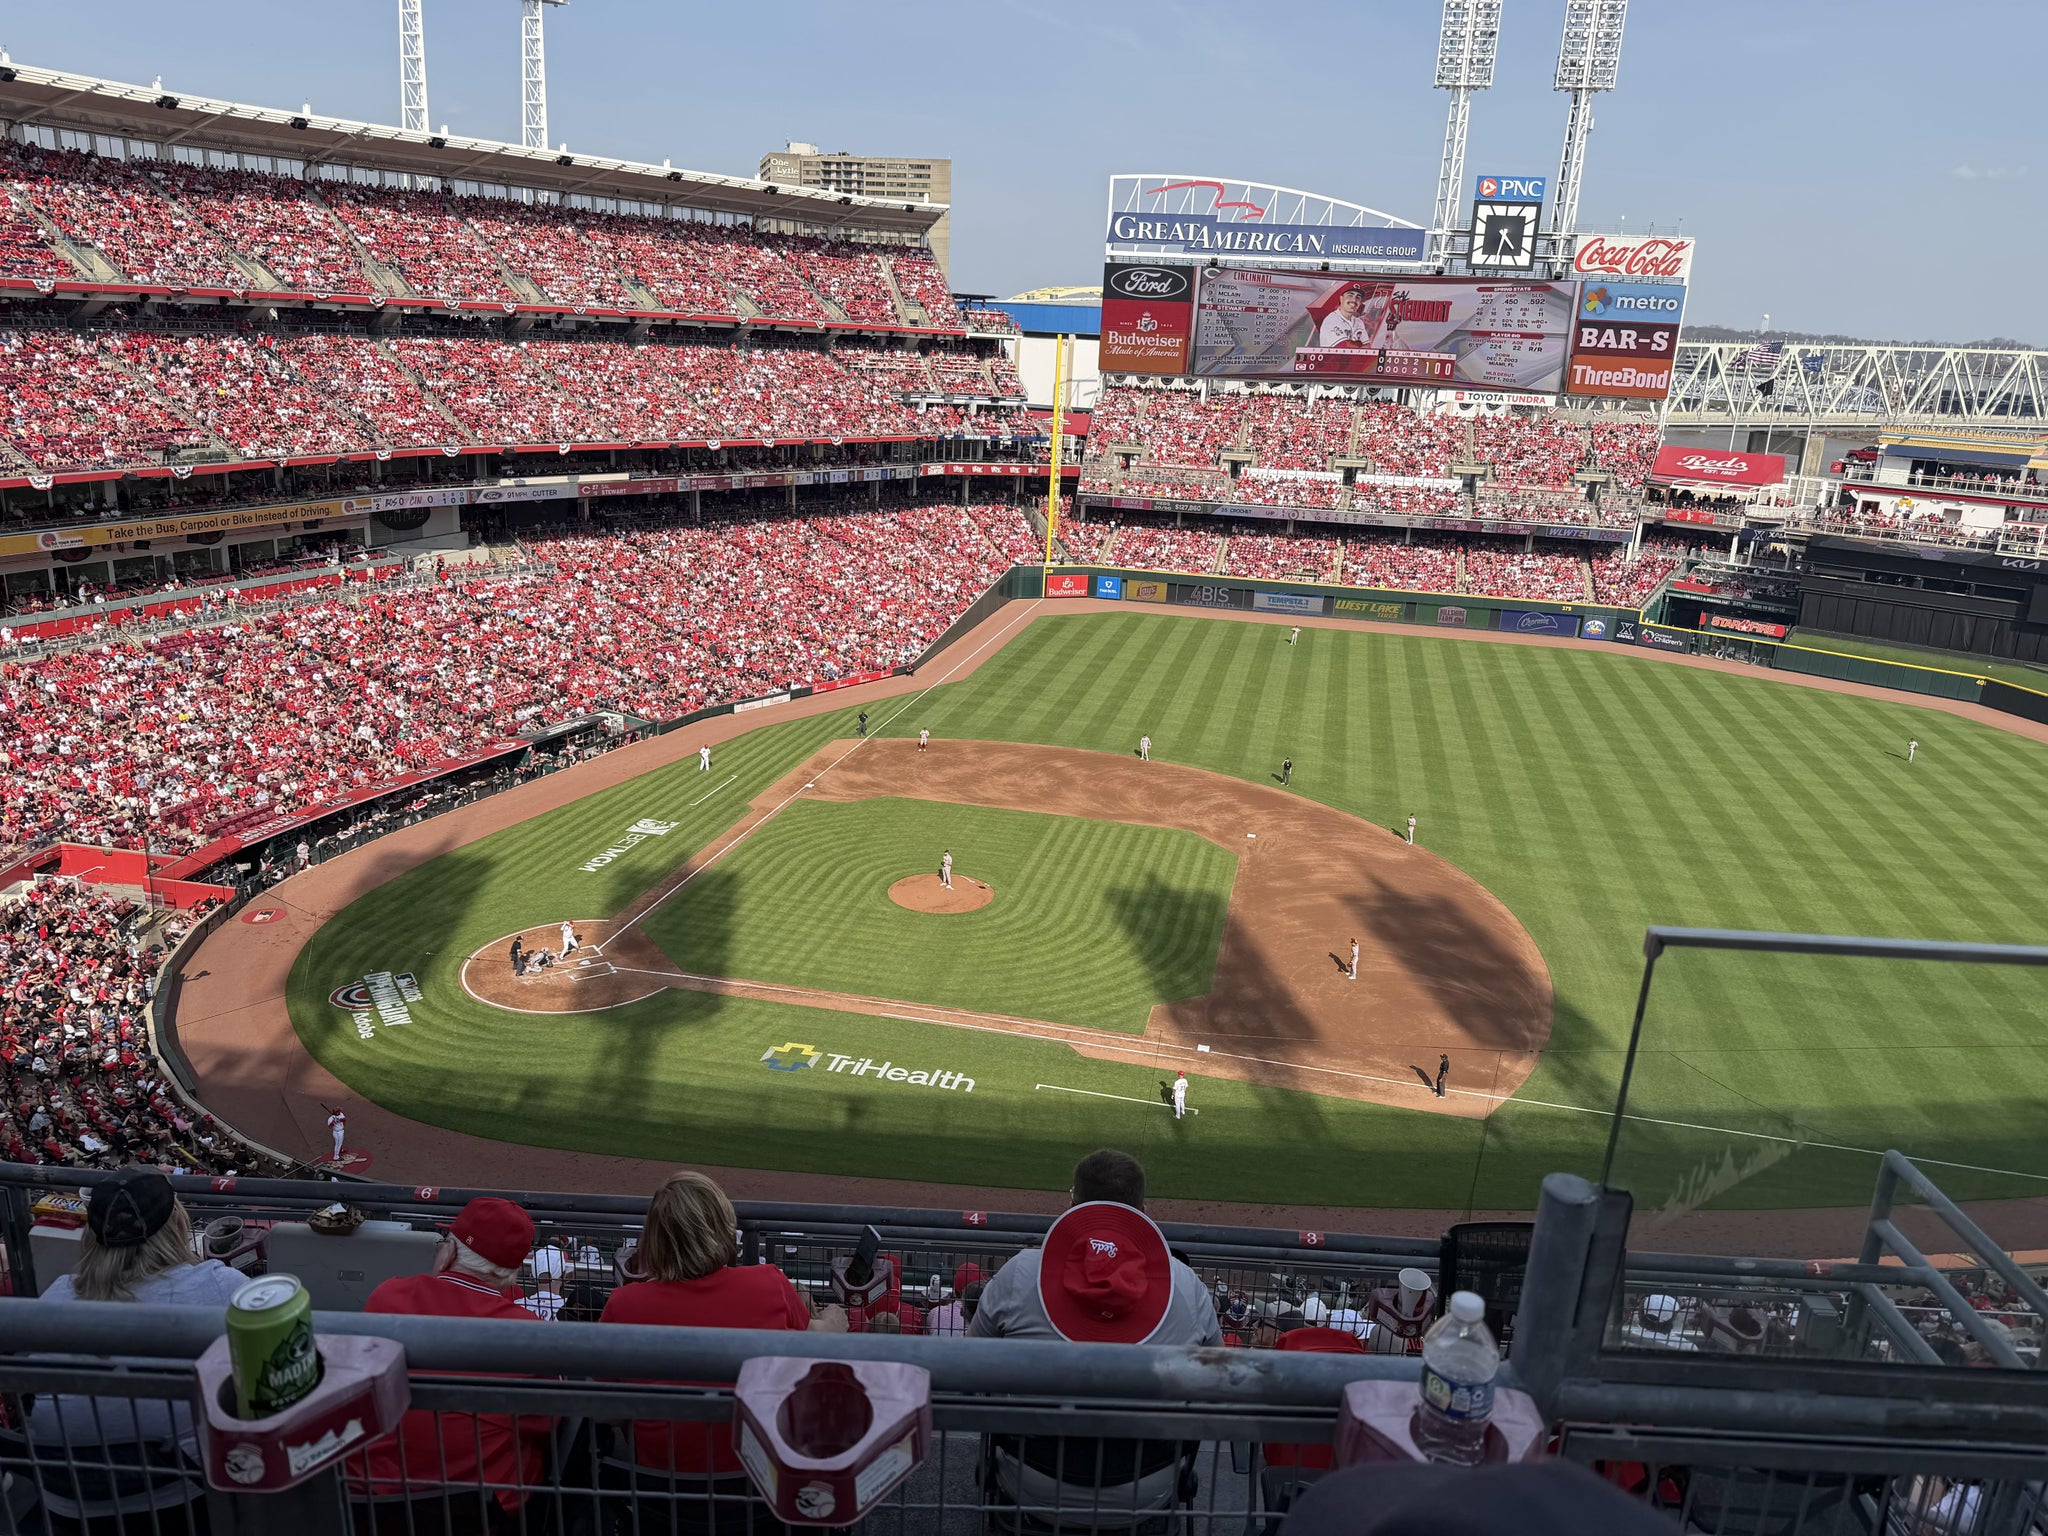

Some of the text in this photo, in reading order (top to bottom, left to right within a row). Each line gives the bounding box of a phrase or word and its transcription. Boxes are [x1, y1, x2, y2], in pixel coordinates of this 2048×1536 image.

[1500, 180, 1542, 197] PNC
[1114, 216, 1200, 241] GREAT
[1332, 244, 1383, 255] INSURANCE
[1387, 247, 1417, 256] GROUP
[1125, 271, 1172, 293] Ford
[1234, 272, 1271, 283] CINCINNATI
[1392, 291, 1410, 300] SAL
[1616, 294, 1678, 311] metro
[1390, 300, 1452, 322] STEWART
[1108, 331, 1182, 347] Budweiser
[1580, 328, 1670, 351] BAR-S
[1105, 346, 1179, 357] Made of America
[1426, 362, 1451, 375] 1 0 0
[1573, 365, 1669, 388] ThreeBond
[1468, 393, 1546, 404] TOYOTA TUNDRA
[1676, 455, 1748, 471] Reds
[385, 498, 397, 507] BOS
[410, 496, 422, 506] CIN
[107, 506, 332, 539] Take the Bus, Carpool or Bike Instead of Driving.
[1191, 586, 1229, 602] 4BIS
[1335, 600, 1401, 614] WEST LAKE
[1711, 616, 1776, 634] STAR FIRE
[1654, 637, 1682, 646] Children's
[578, 834, 648, 872] BETMGM
[364, 972, 403, 1012] OPENING
[379, 1006, 412, 1026] DAY
[352, 1012, 376, 1039] Adobe
[826, 1054, 975, 1092] TriHealth
[219, 1179, 229, 1191] 7
[421, 1188, 432, 1199] 6
[969, 1213, 979, 1224] 4
[1307, 1232, 1317, 1244] 3
[1089, 1238, 1118, 1258] Reds
[1814, 1263, 1822, 1274] 1
